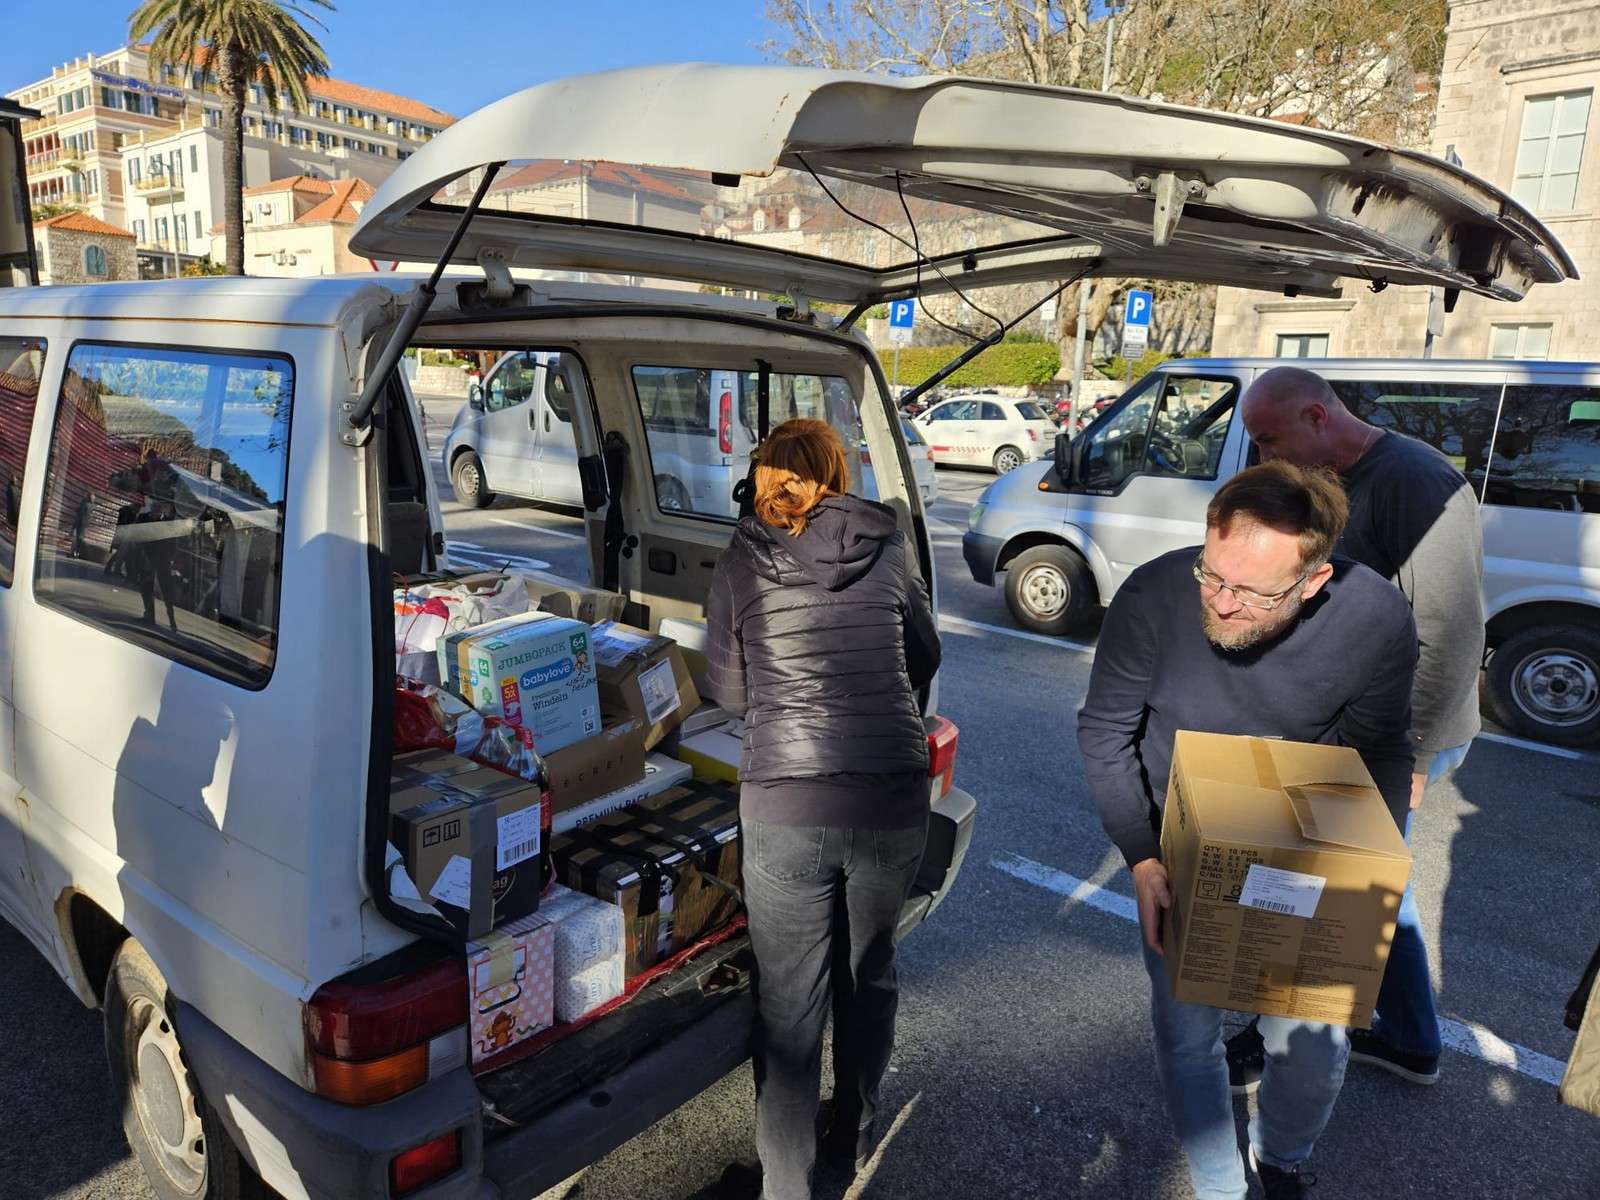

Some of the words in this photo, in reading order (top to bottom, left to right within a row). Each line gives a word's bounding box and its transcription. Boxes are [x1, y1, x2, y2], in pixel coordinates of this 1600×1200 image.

[896, 303, 909, 322] P
[1132, 297, 1146, 319] P
[573, 636, 585, 648] 64
[498, 641, 567, 670] JUMBOPACK
[523, 663, 571, 687] babylove
[532, 693, 569, 711] Windeln
